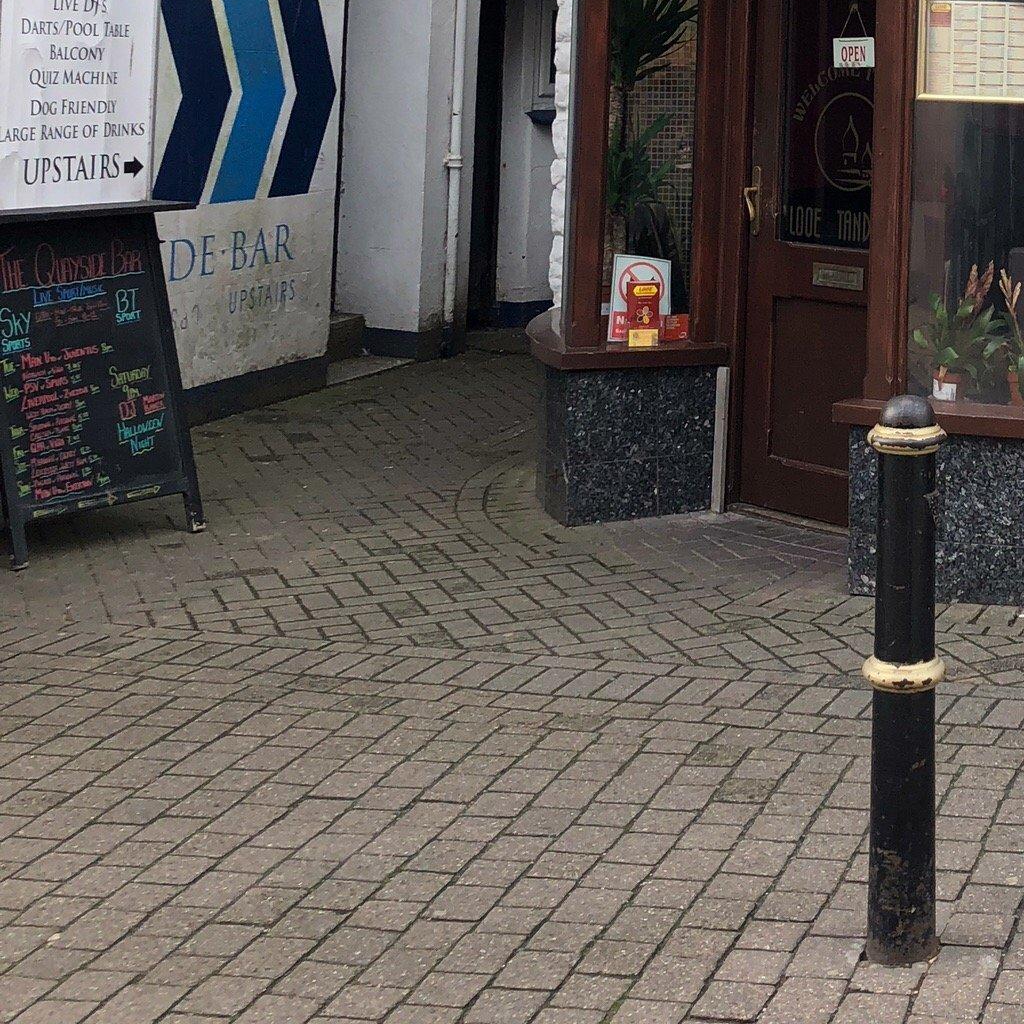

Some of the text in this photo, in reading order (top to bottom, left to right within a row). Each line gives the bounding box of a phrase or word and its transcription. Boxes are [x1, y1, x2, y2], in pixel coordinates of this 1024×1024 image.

[104, 22, 130, 38] TABLE
[49, 45, 105, 61] BALCONY
[841, 45, 866, 63] OPEN
[29, 69, 118, 89] QUIZ MACHINE
[30, 99, 58, 116] DOG
[40, 124, 78, 141] RANGE
[83, 123, 99, 138] OF
[104, 121, 145, 137] DRINKS
[23, 153, 121, 186] UPSTAIRS
[790, 205, 822, 238] LOOE
[111, 239, 142, 275] BAR
[115, 288, 139, 313] BT
[229, 279, 295, 314] UPSTAIRS
[115, 310, 141, 323] SPORT
